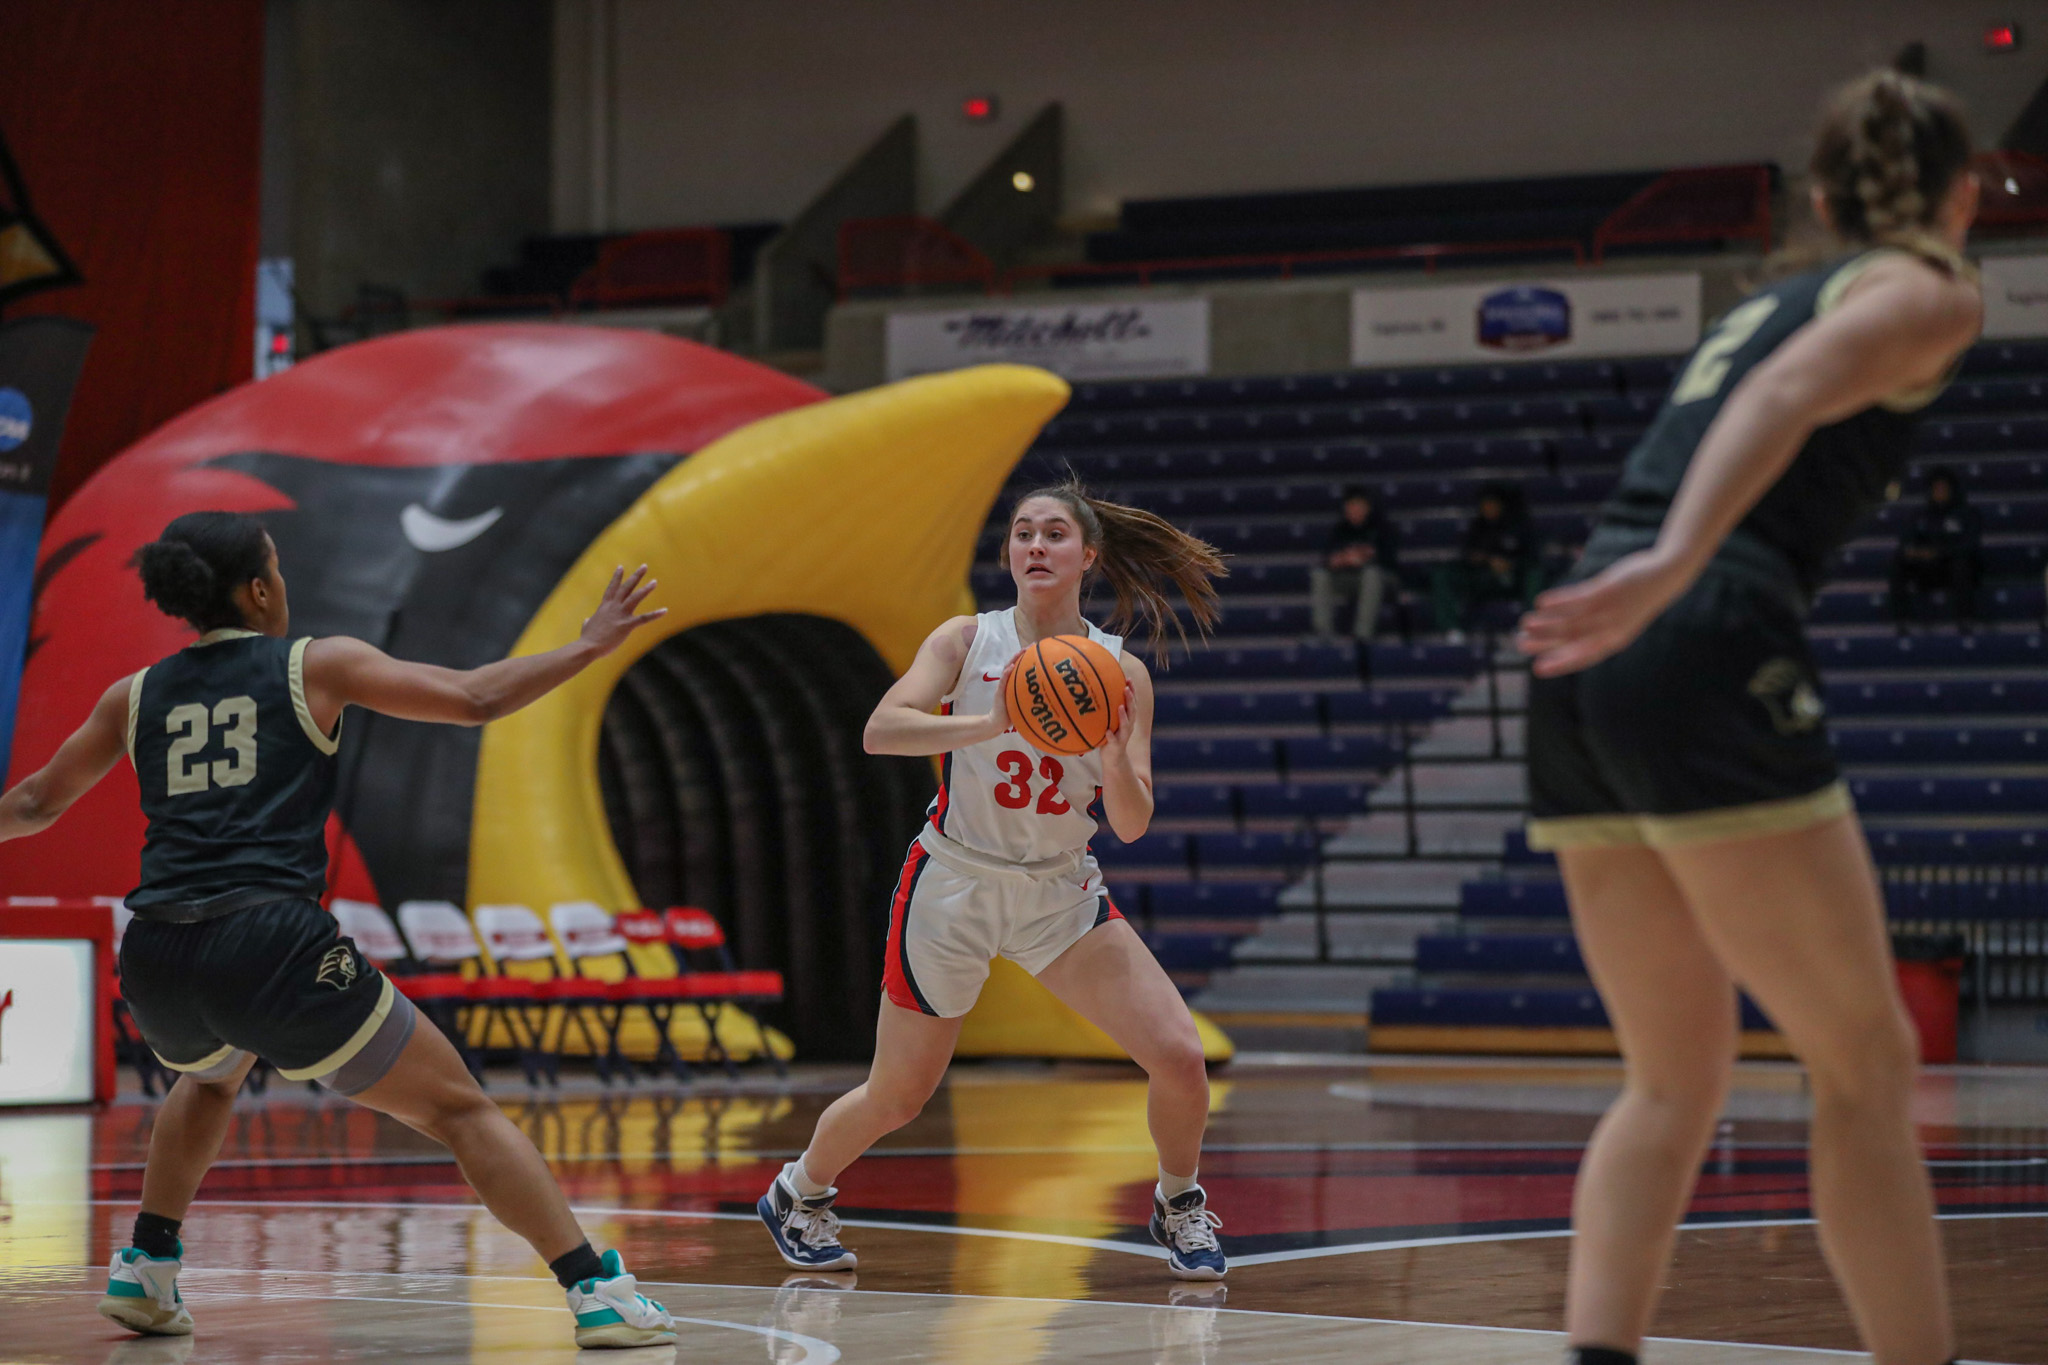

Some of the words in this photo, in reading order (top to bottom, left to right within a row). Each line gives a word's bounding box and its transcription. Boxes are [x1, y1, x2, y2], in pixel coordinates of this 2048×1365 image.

[1671, 294, 1779, 406] 2
[1025, 666, 1068, 743] Wilson
[1054, 658, 1096, 715] NCAA
[166, 695, 257, 797] 23
[994, 750, 1070, 815] 32
